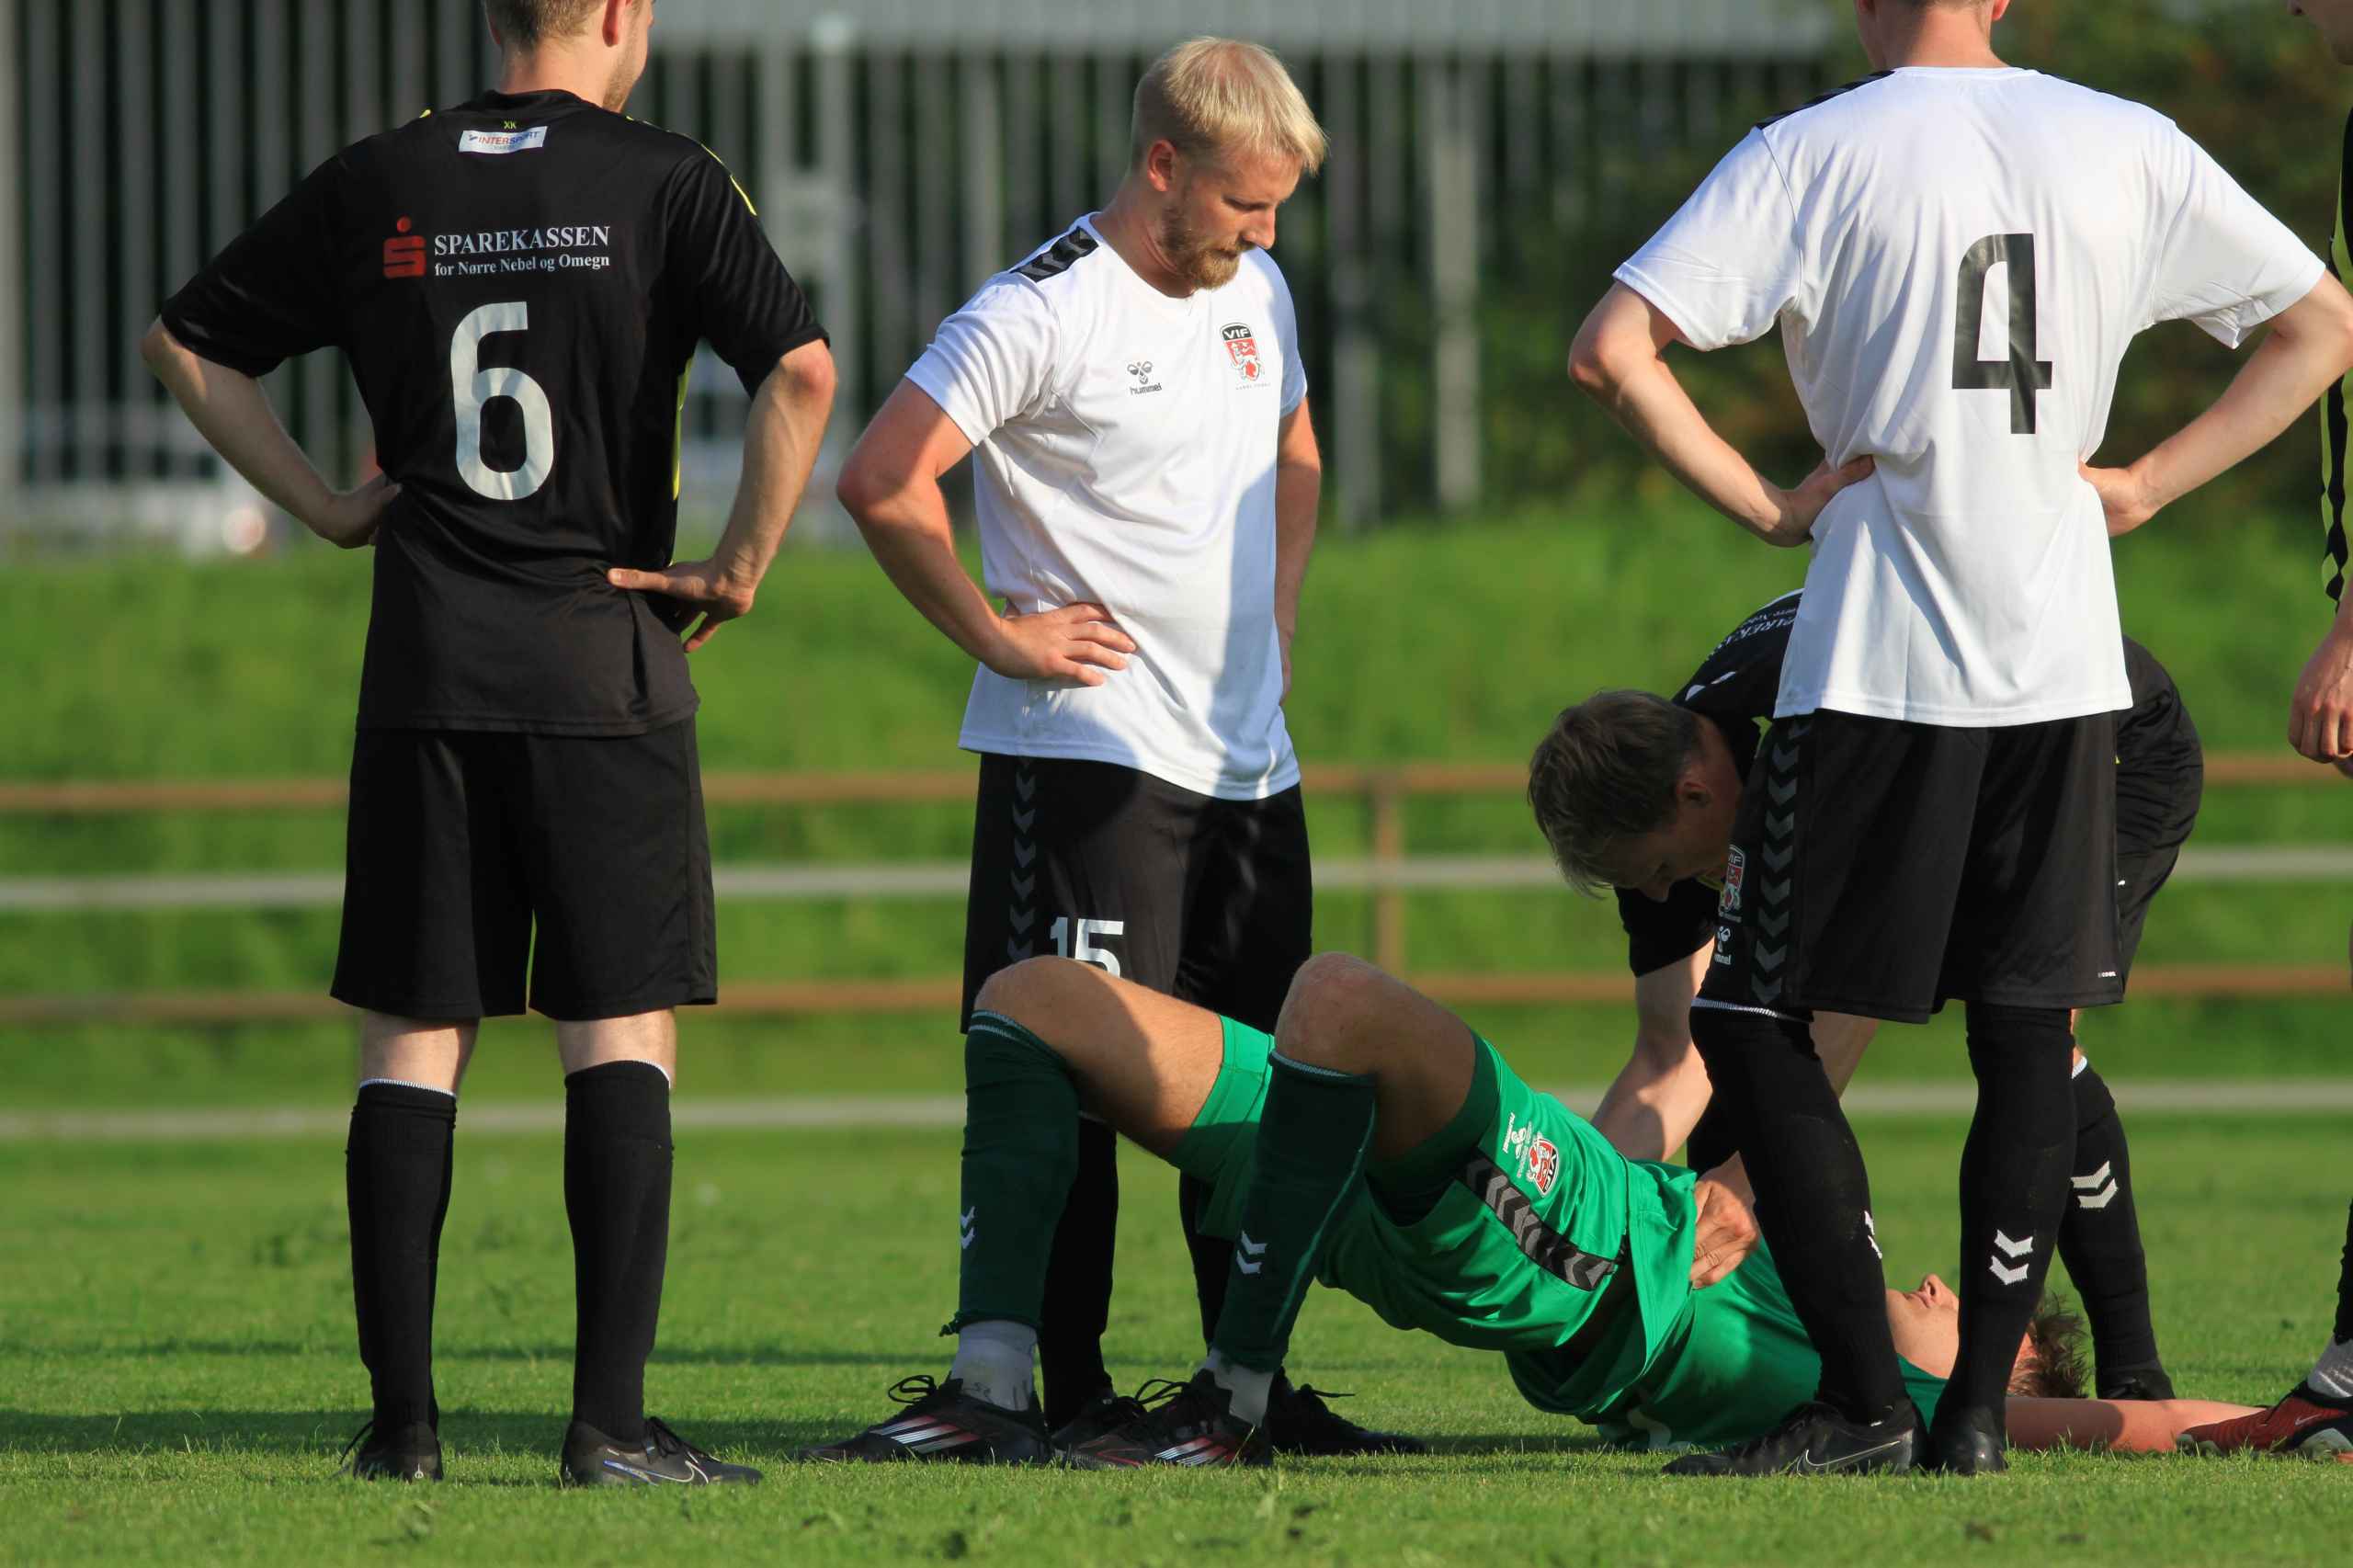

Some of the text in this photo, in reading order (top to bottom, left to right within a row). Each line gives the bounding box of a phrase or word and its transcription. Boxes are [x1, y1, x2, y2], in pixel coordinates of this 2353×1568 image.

[434, 226, 610, 256] SPAREKASSEN
[435, 253, 610, 277] for Nørre Nebel og Omegn
[1223, 327, 1249, 340] VIF
[1951, 233, 2052, 435] 4
[449, 301, 554, 501] 6
[1130, 382, 1163, 395] hummel
[1049, 916, 1124, 979] 15
